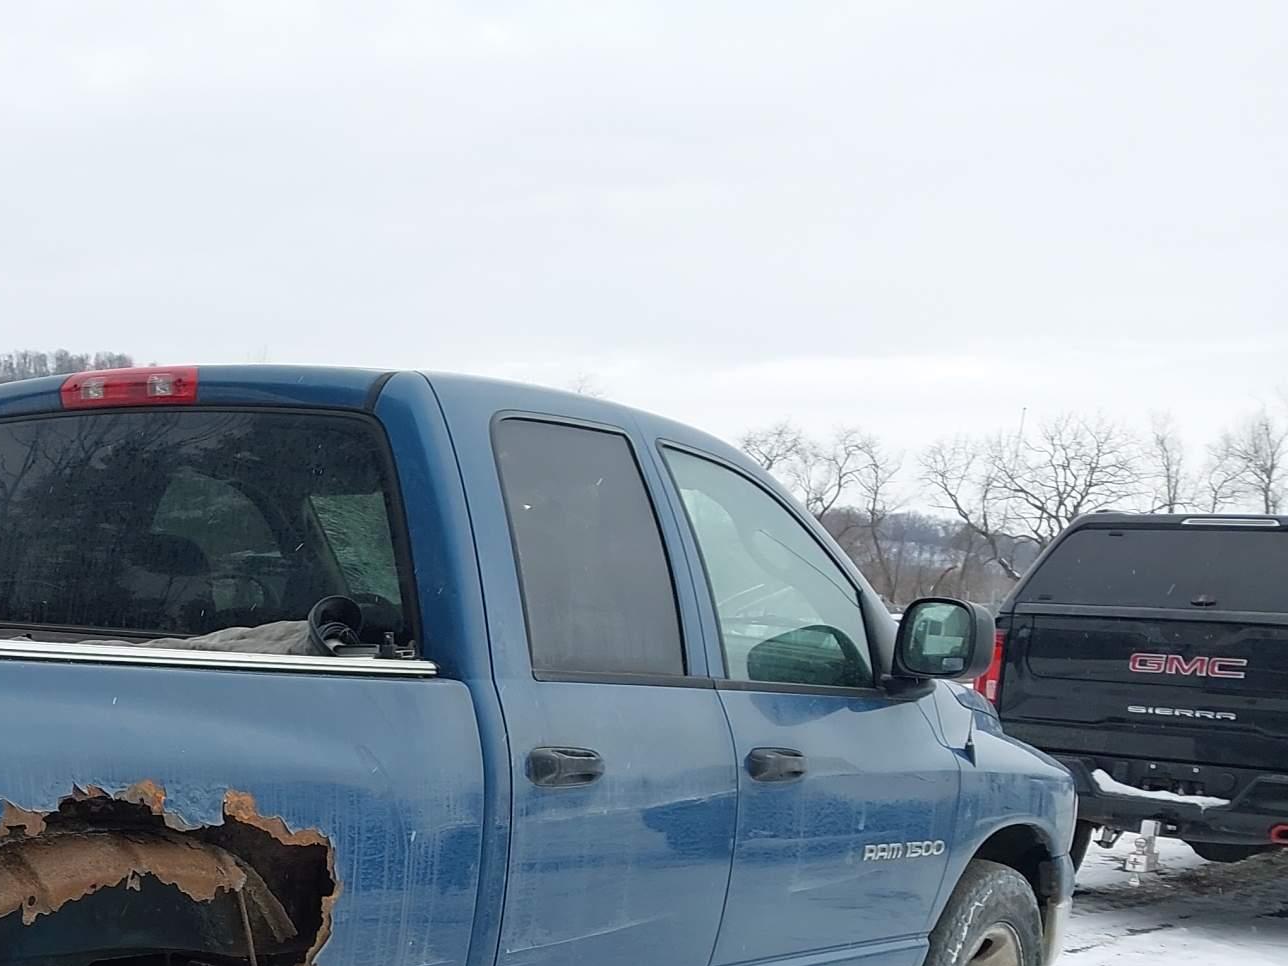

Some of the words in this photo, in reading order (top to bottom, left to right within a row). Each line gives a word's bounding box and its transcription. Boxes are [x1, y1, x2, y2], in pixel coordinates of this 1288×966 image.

[1128, 652, 1248, 679] GMC
[1127, 705, 1237, 721] SIERRA
[863, 843, 902, 861] RAM
[905, 839, 945, 858] 1500
